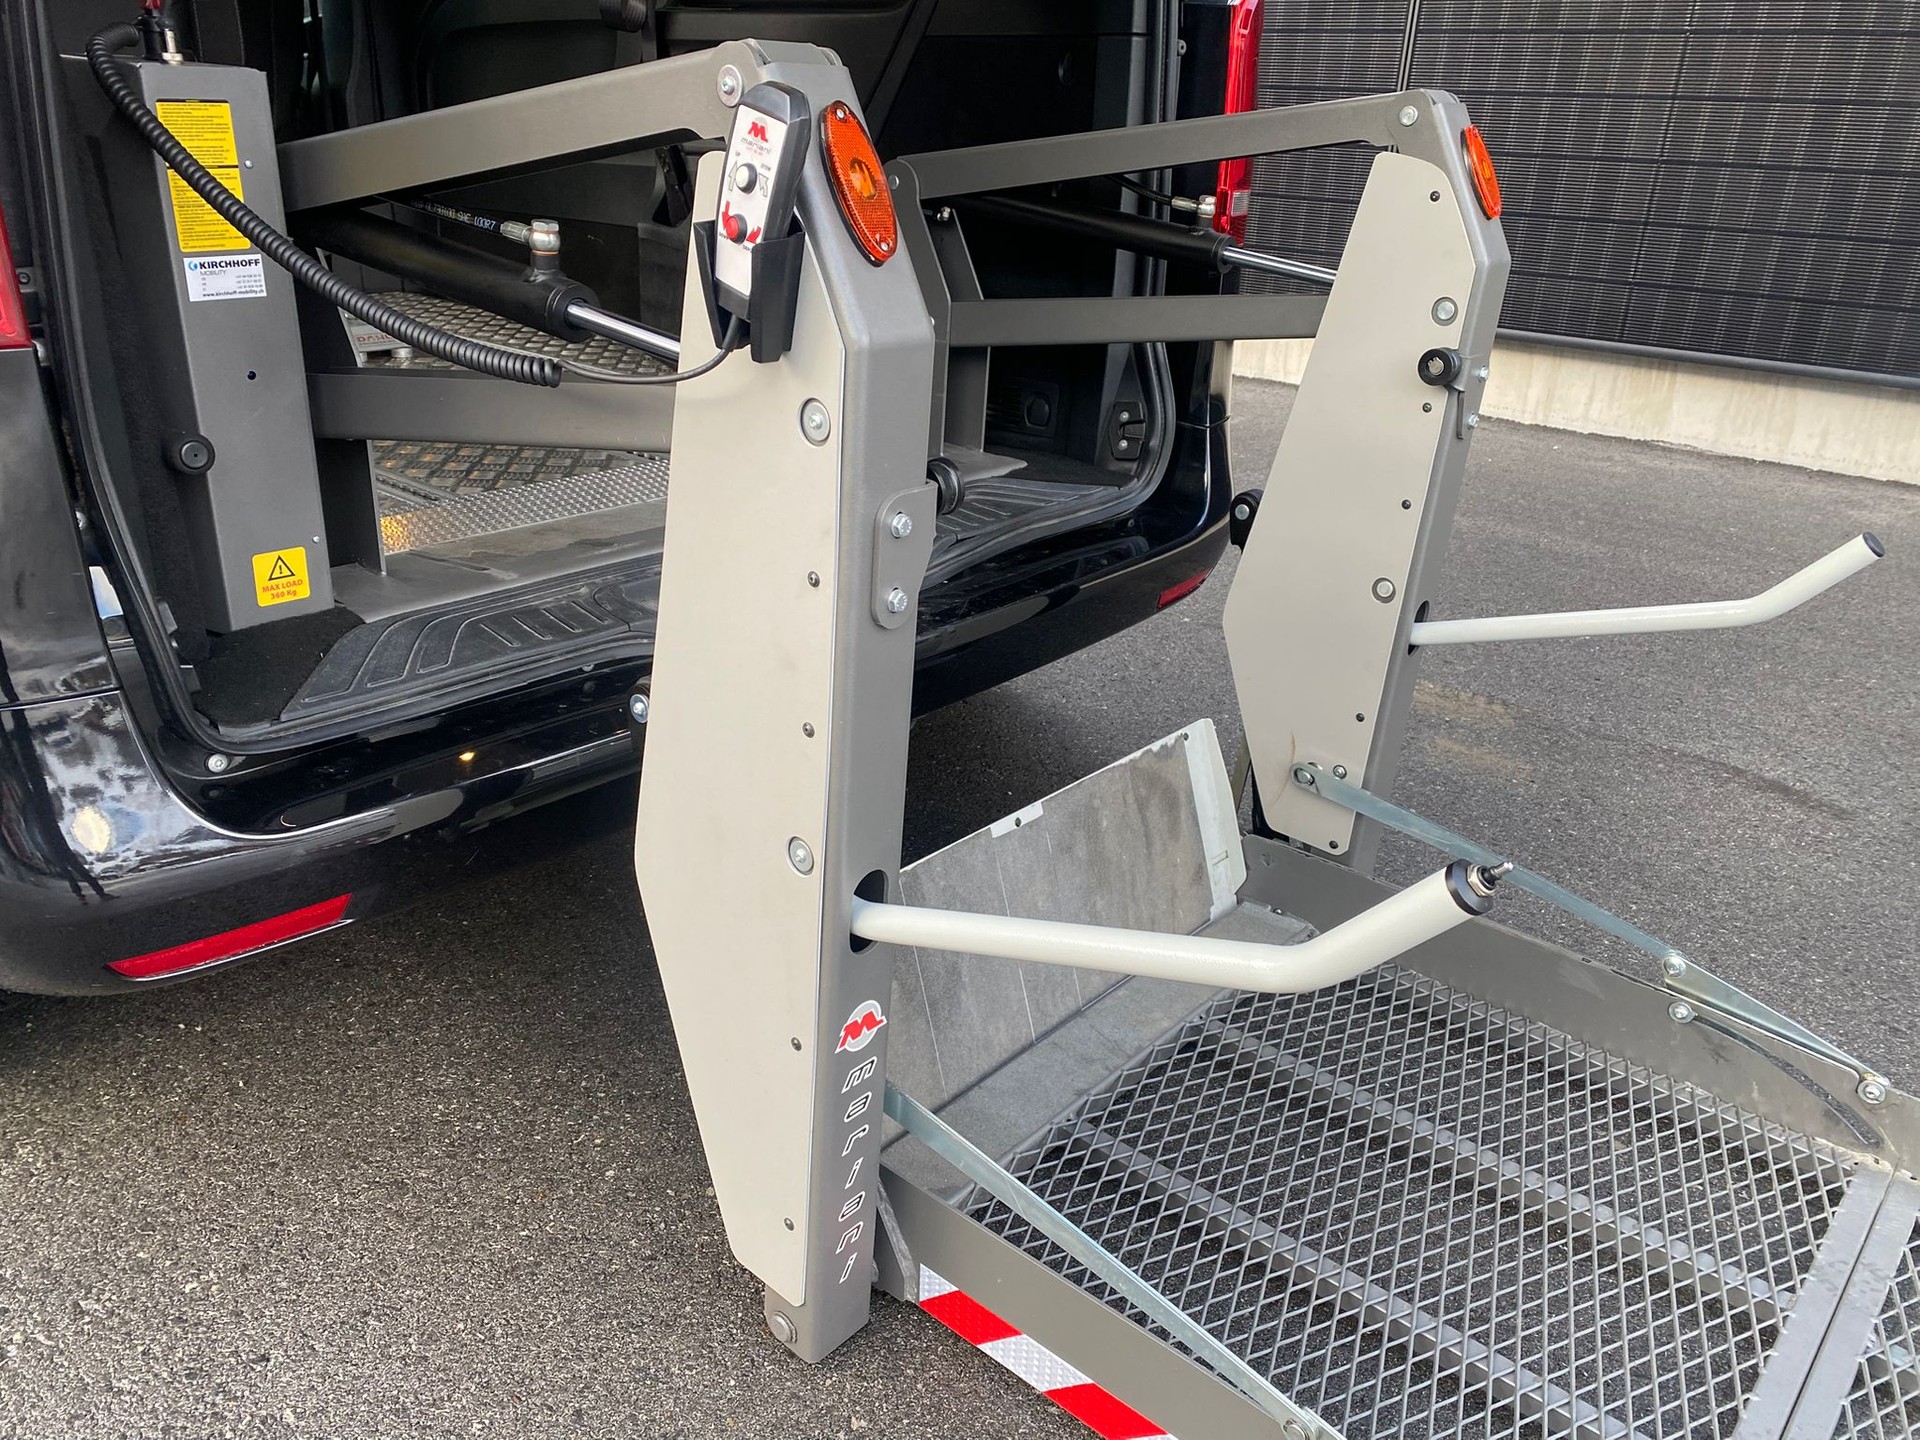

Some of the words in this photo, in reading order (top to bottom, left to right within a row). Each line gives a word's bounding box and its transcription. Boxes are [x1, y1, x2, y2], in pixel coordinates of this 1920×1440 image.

[740, 137, 772, 155] mariani
[457, 210, 472, 224] SAE
[474, 216, 496, 231] 100R7
[199, 258, 261, 270] KIRCHHOFF
[202, 289, 264, 297] www.kirchhoff-mobility.ch
[262, 584, 280, 592] MAX
[281, 579, 303, 588] LOAD
[835, 1055, 878, 1285] mariani
